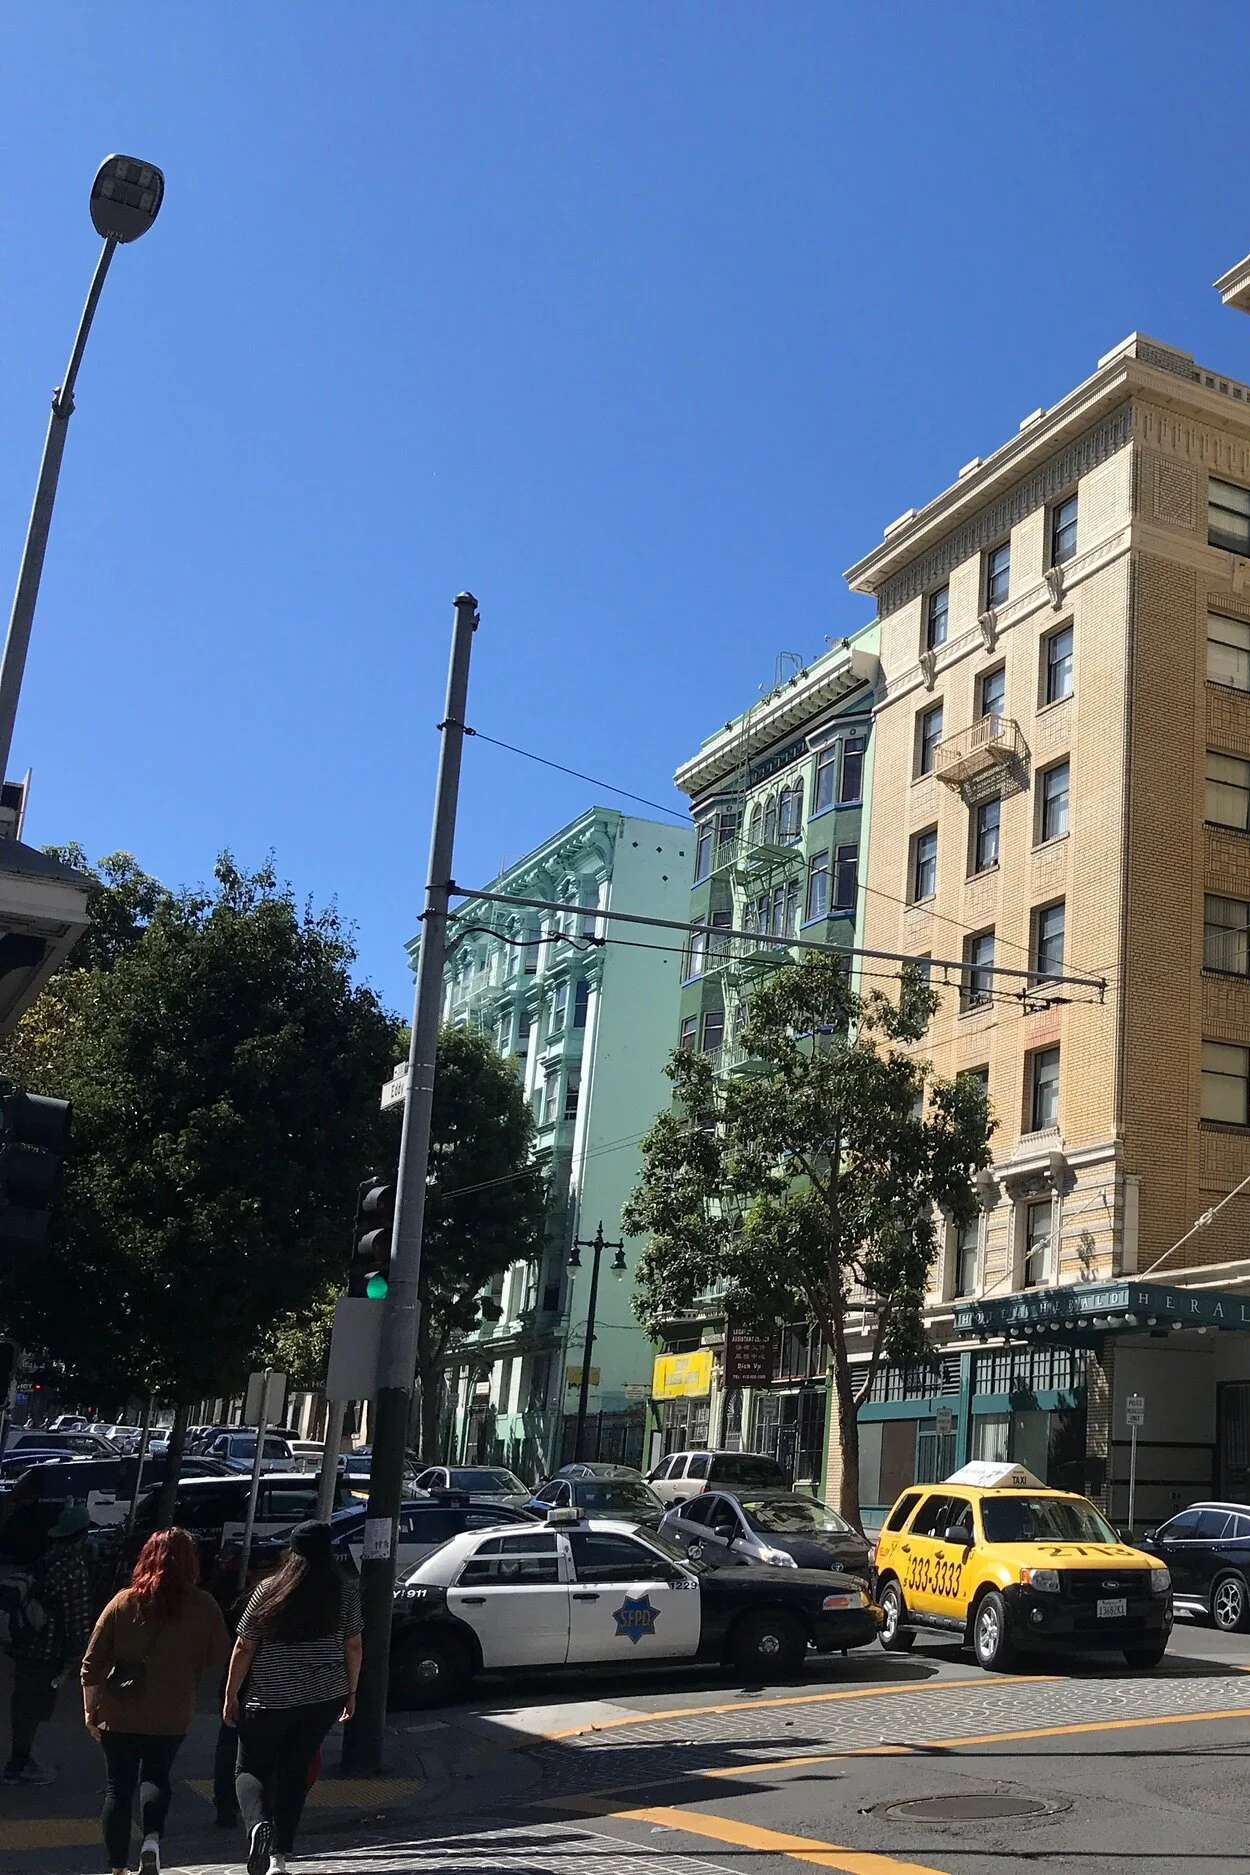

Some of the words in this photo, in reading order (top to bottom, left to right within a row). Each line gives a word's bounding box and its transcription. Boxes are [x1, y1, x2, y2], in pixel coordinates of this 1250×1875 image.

[391, 1082, 405, 1098] Eddy
[1039, 1294, 1118, 1313] HERALD
[1012, 1475, 1027, 1485] TAXI
[1037, 1546, 1136, 1557] 2713
[908, 1556, 963, 1599] 333-3333
[670, 1581, 698, 1590] 1229
[407, 1590, 428, 1599] 911
